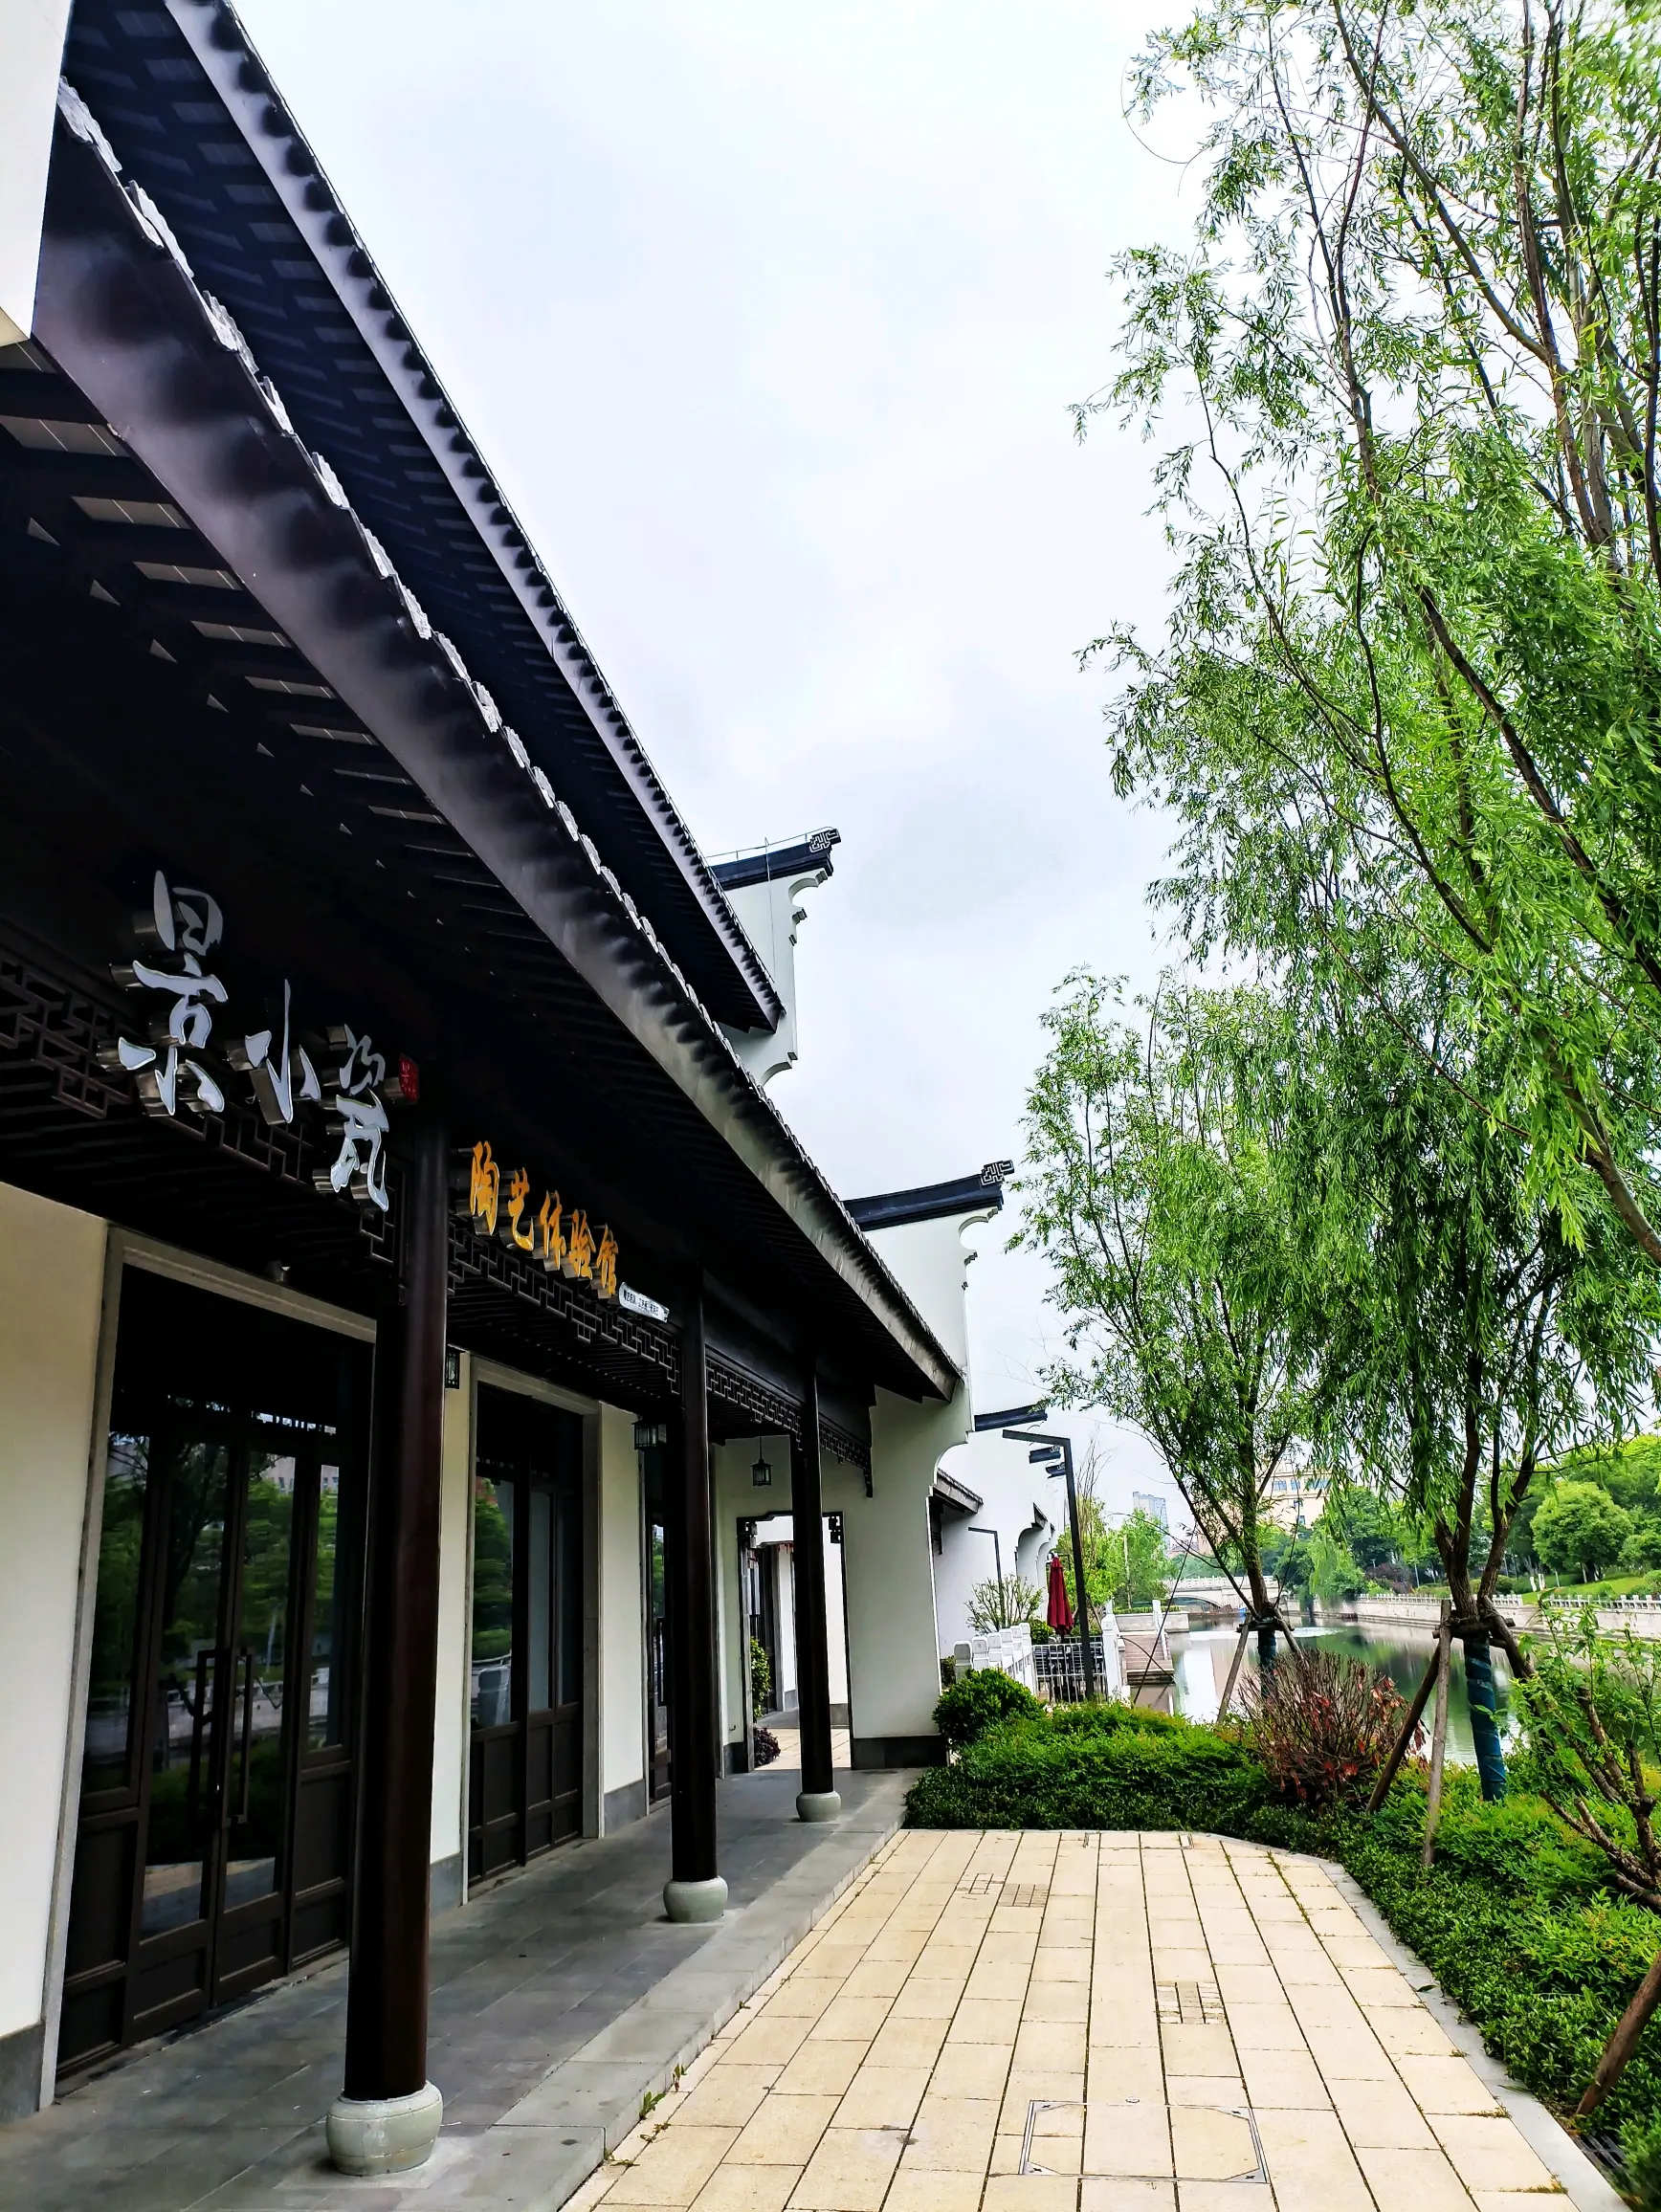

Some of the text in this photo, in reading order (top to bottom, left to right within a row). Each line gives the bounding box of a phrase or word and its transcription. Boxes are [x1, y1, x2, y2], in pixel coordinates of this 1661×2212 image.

[118, 870, 388, 1211] 景小瓷
[470, 1140, 618, 1295] 陶艺体验馆
